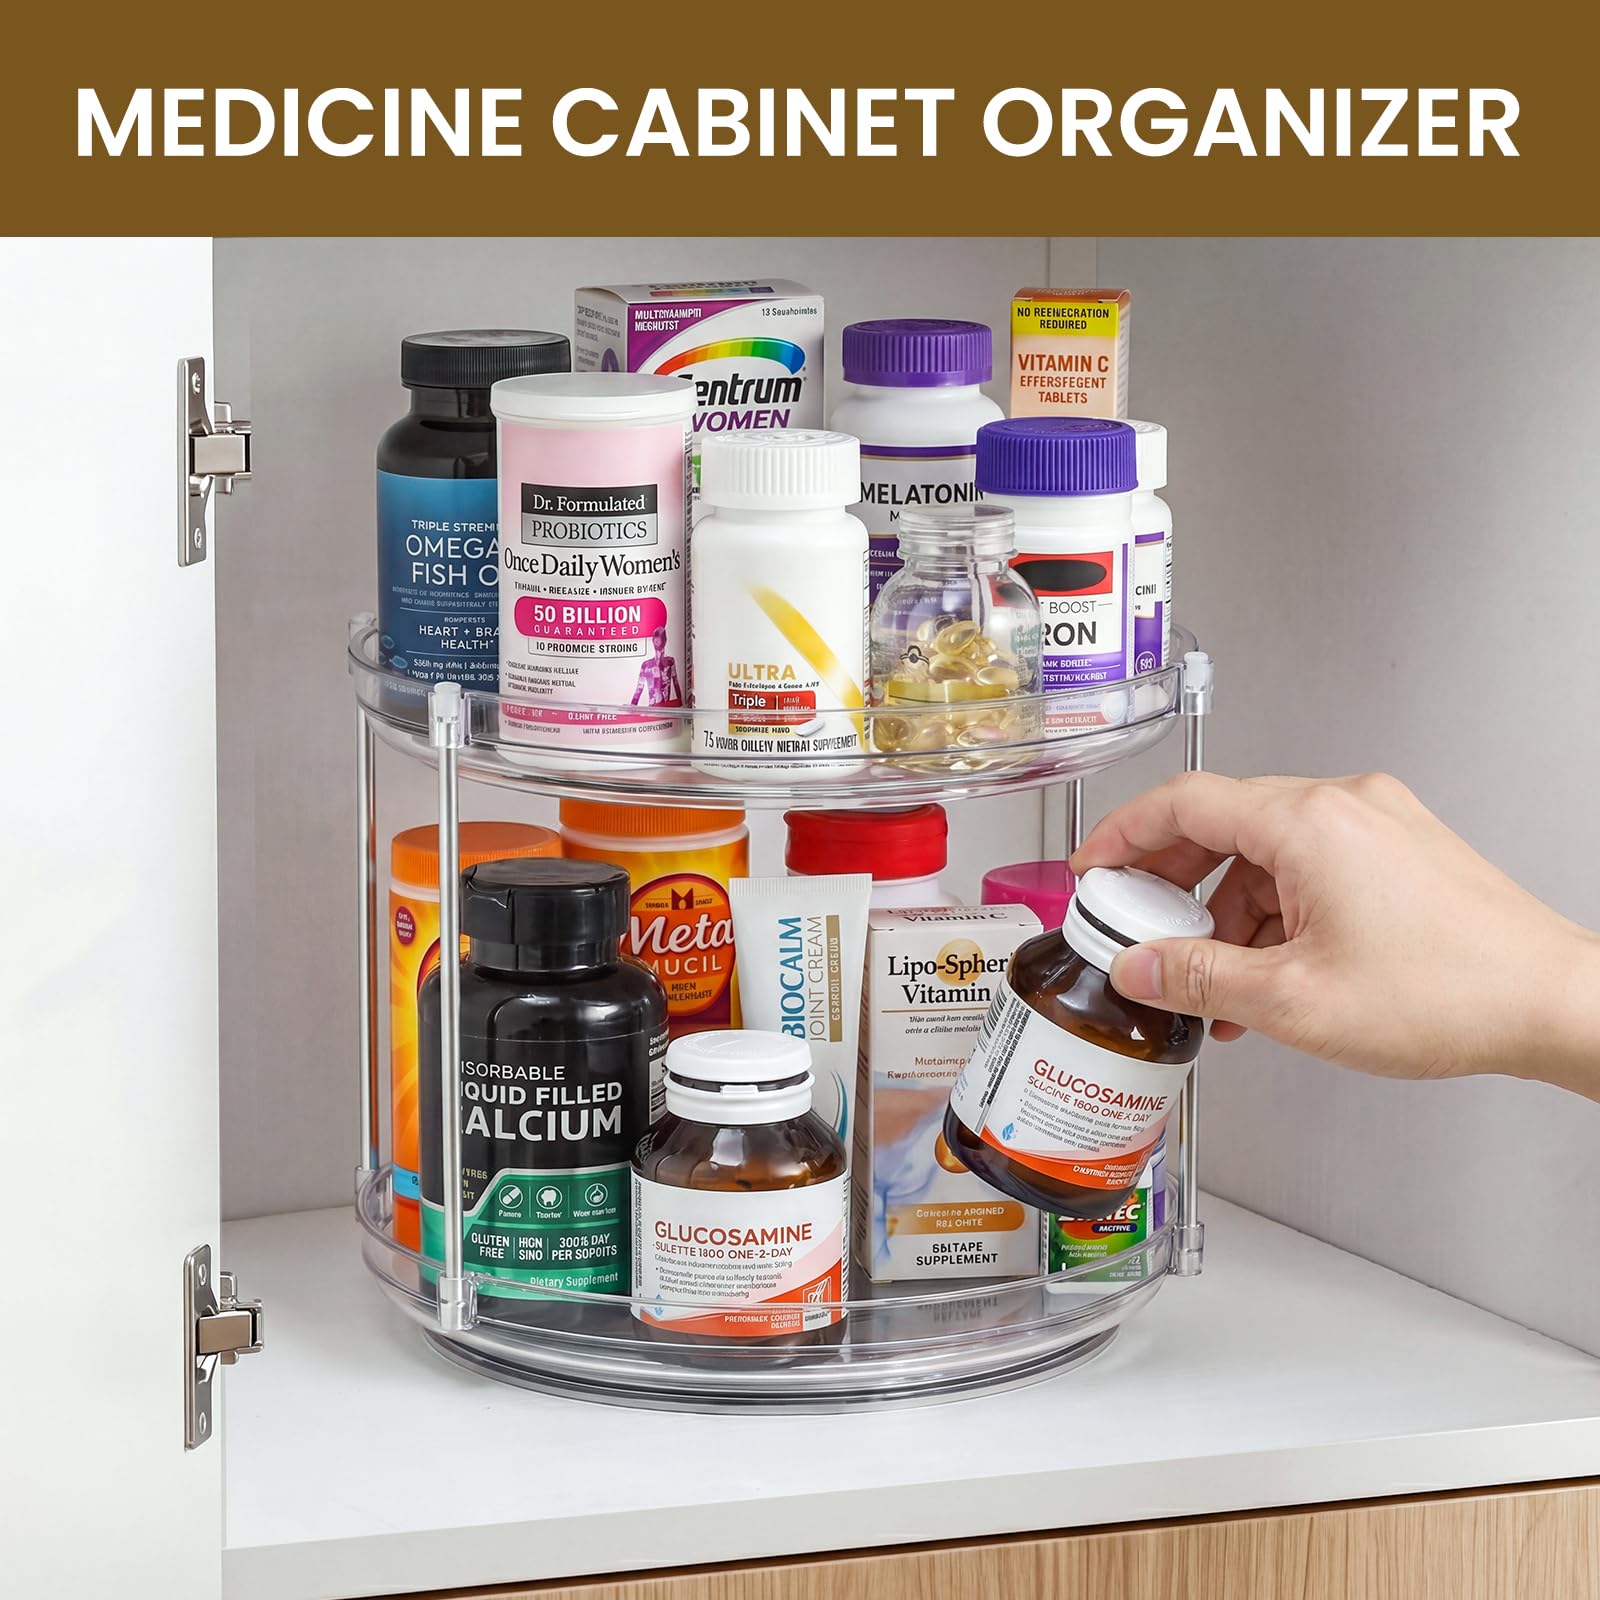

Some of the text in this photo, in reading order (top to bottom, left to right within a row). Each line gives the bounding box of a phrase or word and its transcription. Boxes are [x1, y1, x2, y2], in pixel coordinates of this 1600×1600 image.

[762, 308, 770, 316] 13
[1018, 308, 1030, 317] NO
[1018, 354, 1109, 372] VITAMIN C
[678, 373, 802, 406] entrum
[1038, 392, 1088, 403] TABLETS
[533, 494, 645, 512] Dr. Formulated
[412, 520, 450, 531] TRIPLE
[532, 520, 647, 540] PROBIOTICS
[406, 534, 499, 559] OMEGA
[412, 562, 467, 585] FISH
[505, 547, 681, 583] Once Daily Women's
[534, 605, 641, 624] 50 BILLION
[1050, 600, 1096, 614] BOOST
[419, 625, 458, 636] HEART
[534, 625, 639, 636] GUARANTEED
[728, 663, 796, 681] ULTRA
[732, 693, 766, 709] Triple
[704, 731, 714, 748] 75
[904, 914, 984, 922] Vitamin
[888, 952, 1013, 982] Lipo-Spher
[778, 917, 806, 1039] BIOCALM
[807, 917, 827, 1041] JOINT CREAM
[902, 984, 991, 1004] Vitamin
[536, 1082, 623, 1106] FILLED
[1033, 1059, 1168, 1112] GLUCOSAMINE
[460, 1104, 622, 1141] ALCIUM
[1101, 1108, 1123, 1120] ONE
[1132, 1113, 1152, 1122] DAY
[964, 1207, 1004, 1215] ARGINED
[471, 1233, 510, 1247] GLUTEN
[591, 1233, 610, 1244] DAY
[655, 1220, 813, 1246] GLUCOSAMINE
[480, 1246, 504, 1259] FREE
[519, 1250, 543, 1261] SINO
[552, 1250, 572, 1261] PER
[699, 1248, 724, 1259] 1800
[916, 1253, 998, 1266] SUPPLEMENT
[530, 1272, 618, 1290] Dietary Supplement
